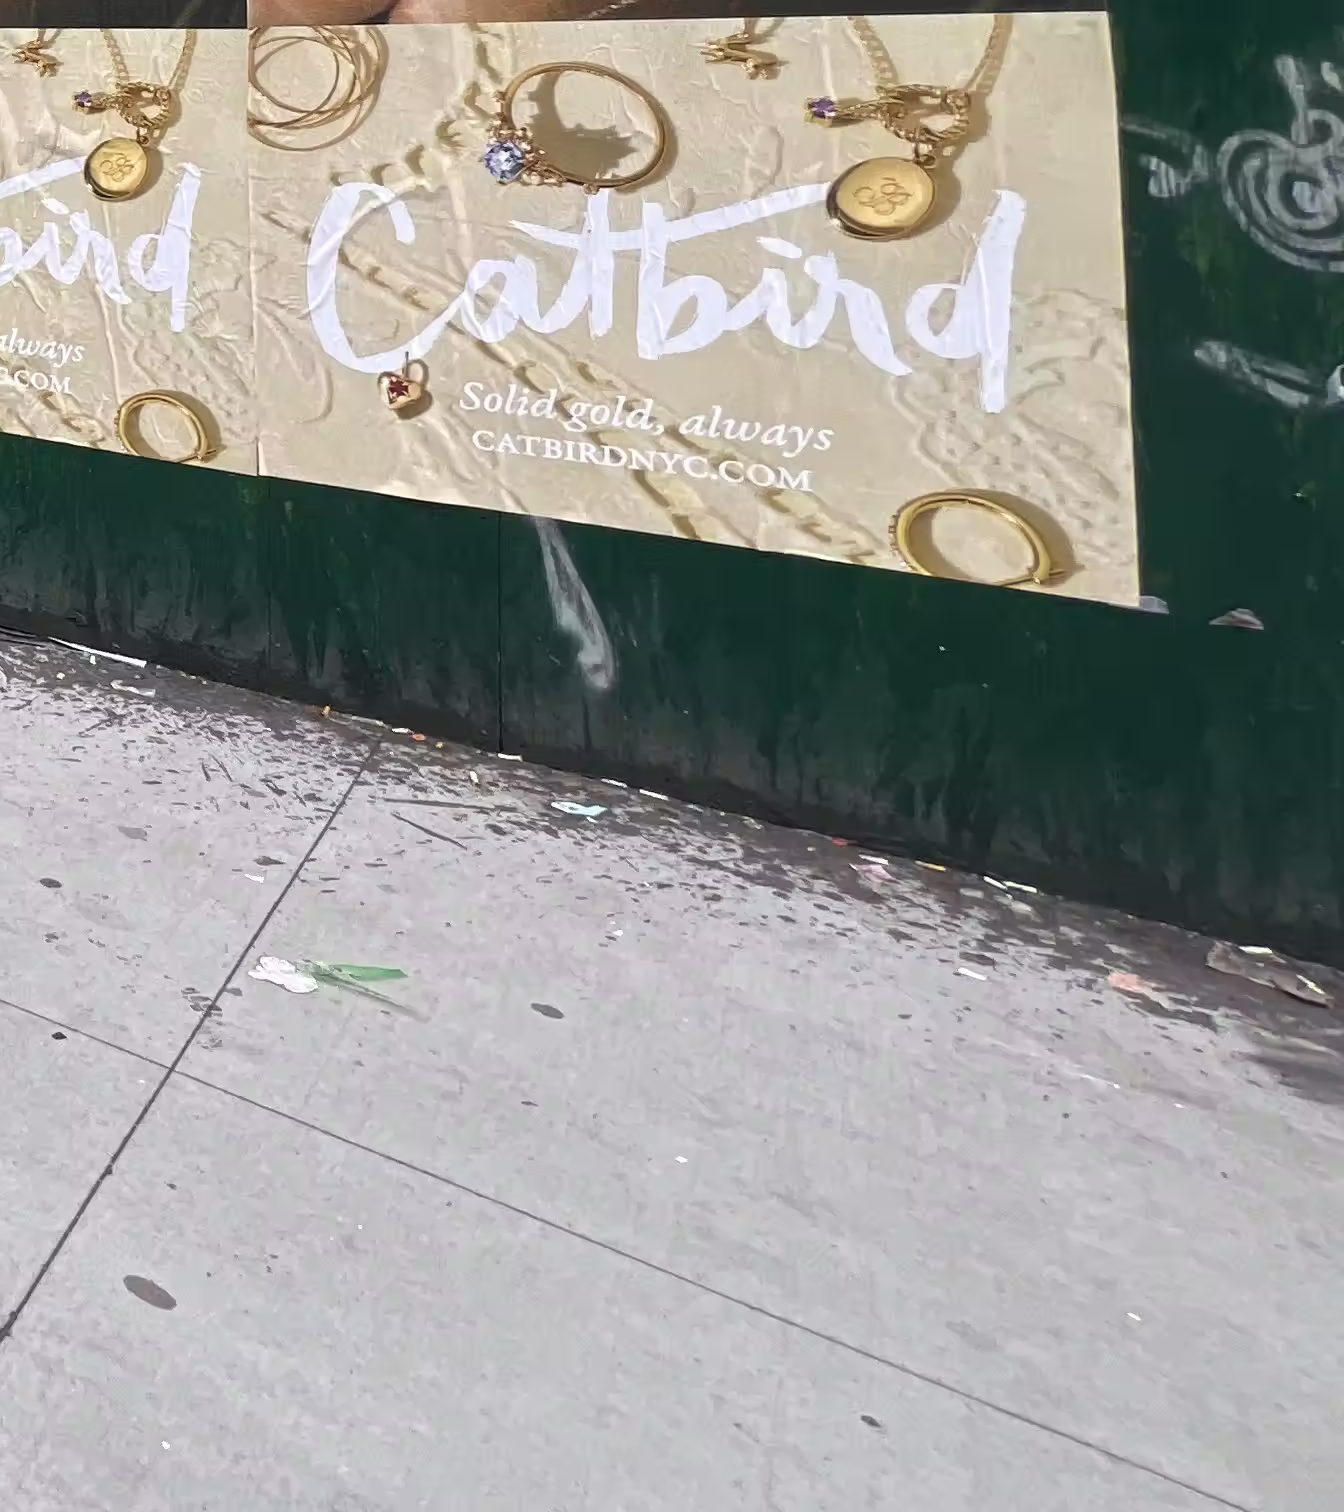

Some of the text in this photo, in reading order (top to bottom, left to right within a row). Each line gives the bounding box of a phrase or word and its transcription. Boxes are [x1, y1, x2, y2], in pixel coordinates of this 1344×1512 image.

[305, 180, 1027, 414] Catbird
[458, 381, 836, 458] Solid gold, always
[471, 429, 814, 493] CATBIRDNYC.COM
